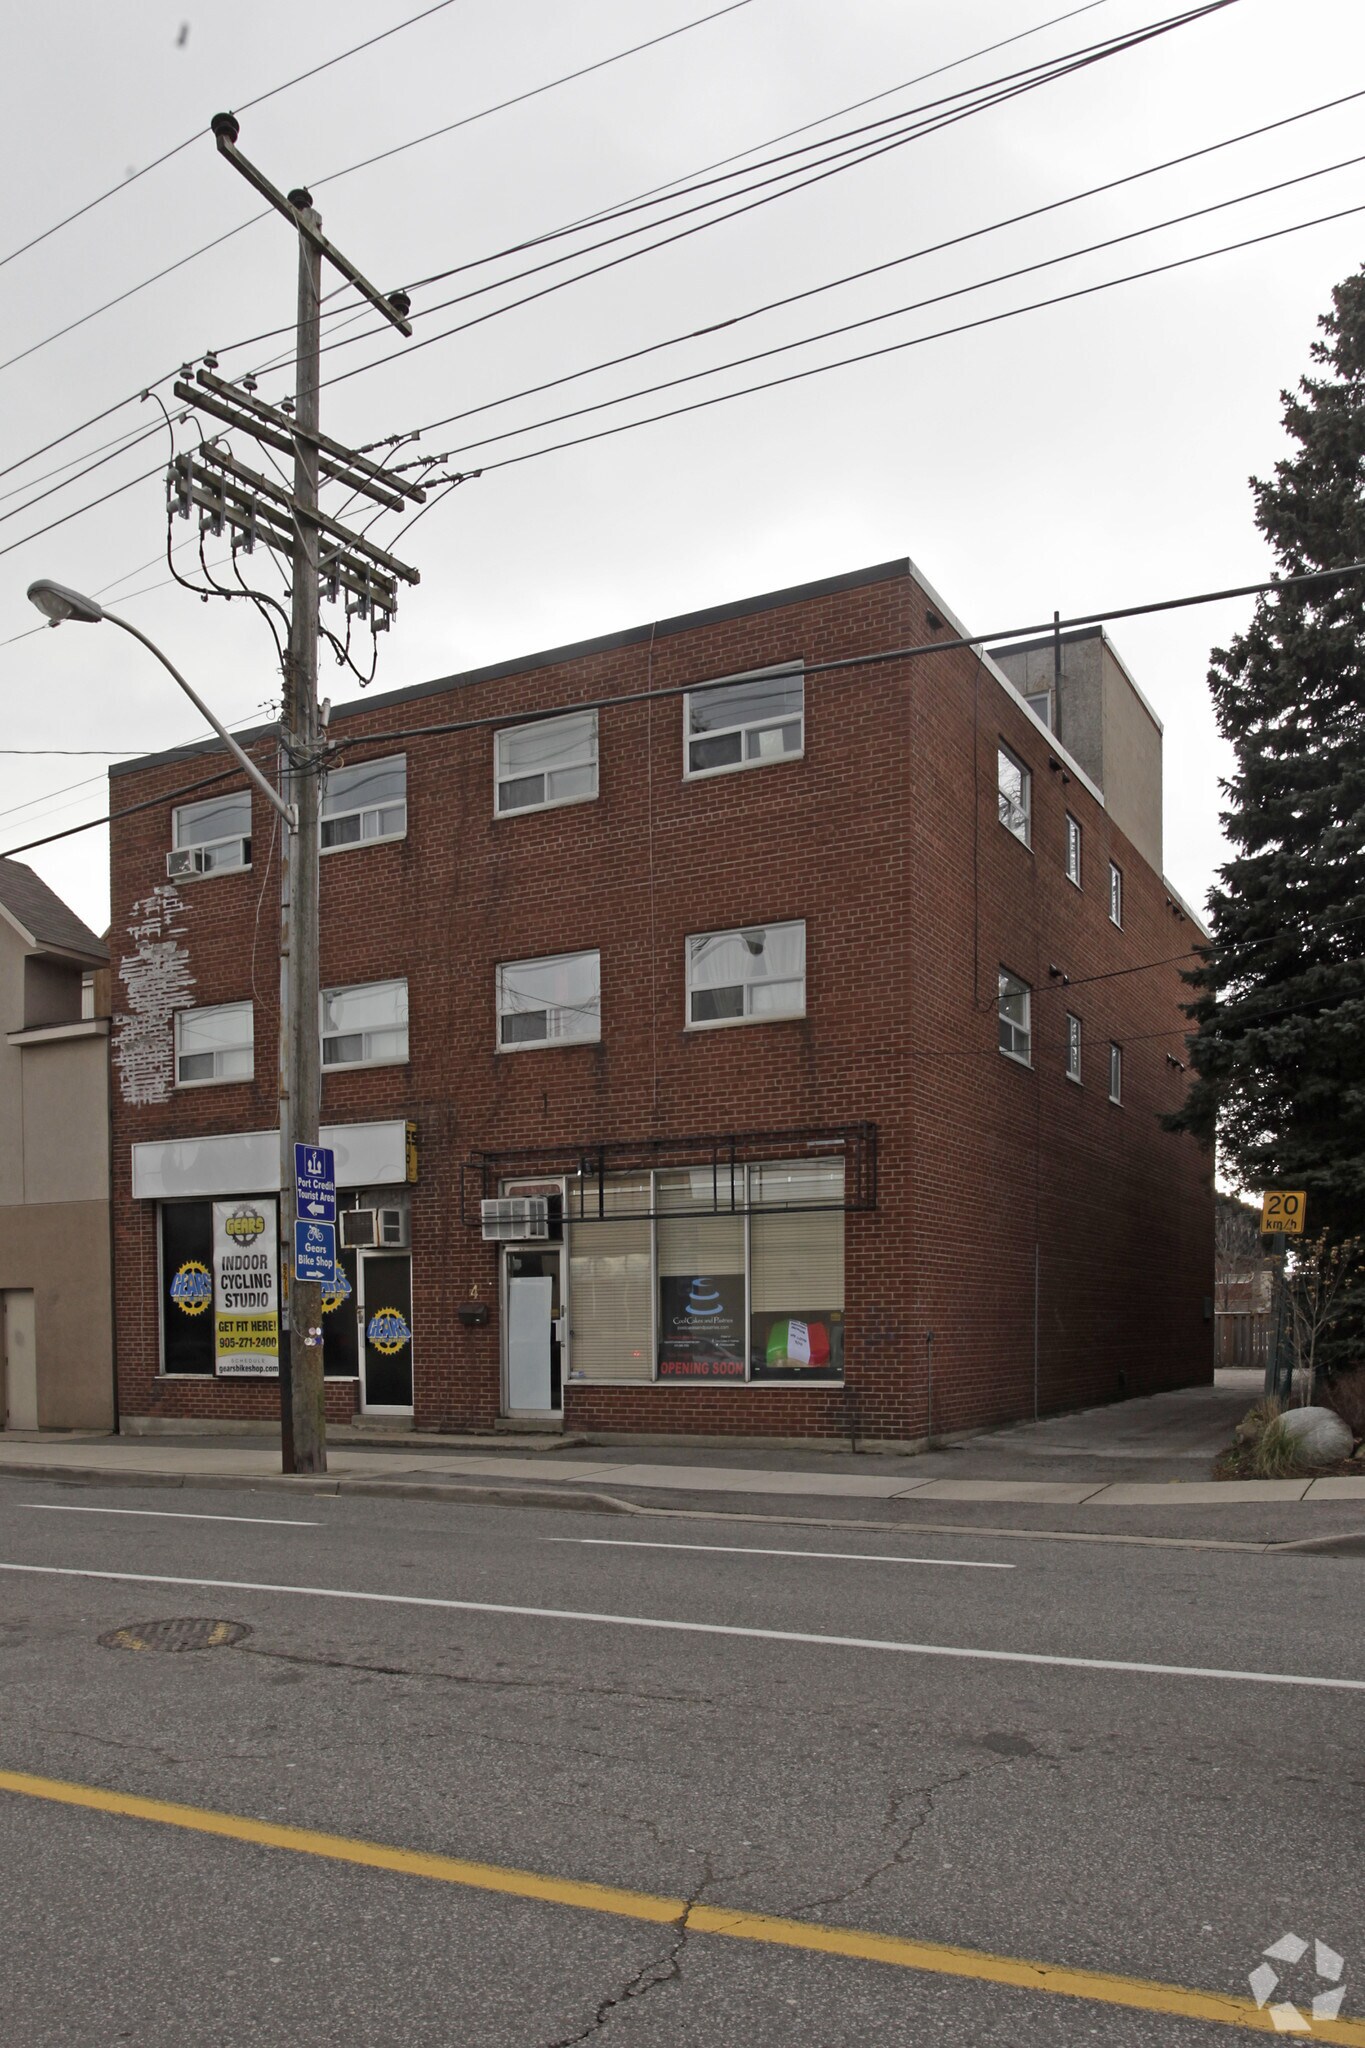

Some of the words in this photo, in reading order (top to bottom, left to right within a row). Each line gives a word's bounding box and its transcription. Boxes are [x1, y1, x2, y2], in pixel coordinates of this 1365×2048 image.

[298, 1177, 311, 1189] Port
[313, 1179, 334, 1191] Credit
[298, 1189, 319, 1201] Tourist
[320, 1192, 335, 1203] Area
[1267, 1195, 1298, 1215] 20
[226, 1216, 264, 1235] GEARS
[1266, 1219, 1297, 1231] km/h
[305, 1242, 327, 1254] Gears
[222, 1254, 268, 1271] INDOOR
[298, 1254, 315, 1266] Bike
[316, 1257, 333, 1270] Shop
[170, 1272, 212, 1297] GEARS
[221, 1273, 272, 1290] CYCLING
[225, 1292, 269, 1308] STUDIO
[219, 1321, 234, 1332] GET
[236, 1321, 248, 1331] FIT
[251, 1320, 277, 1332] HERE!
[367, 1317, 411, 1338] GEARS
[219, 1337, 277, 1348] 905-271-2400
[219, 1364, 279, 1373] gearsbikeshop.com
[660, 1361, 709, 1375] OPENING
[712, 1361, 744, 1375] SOON
